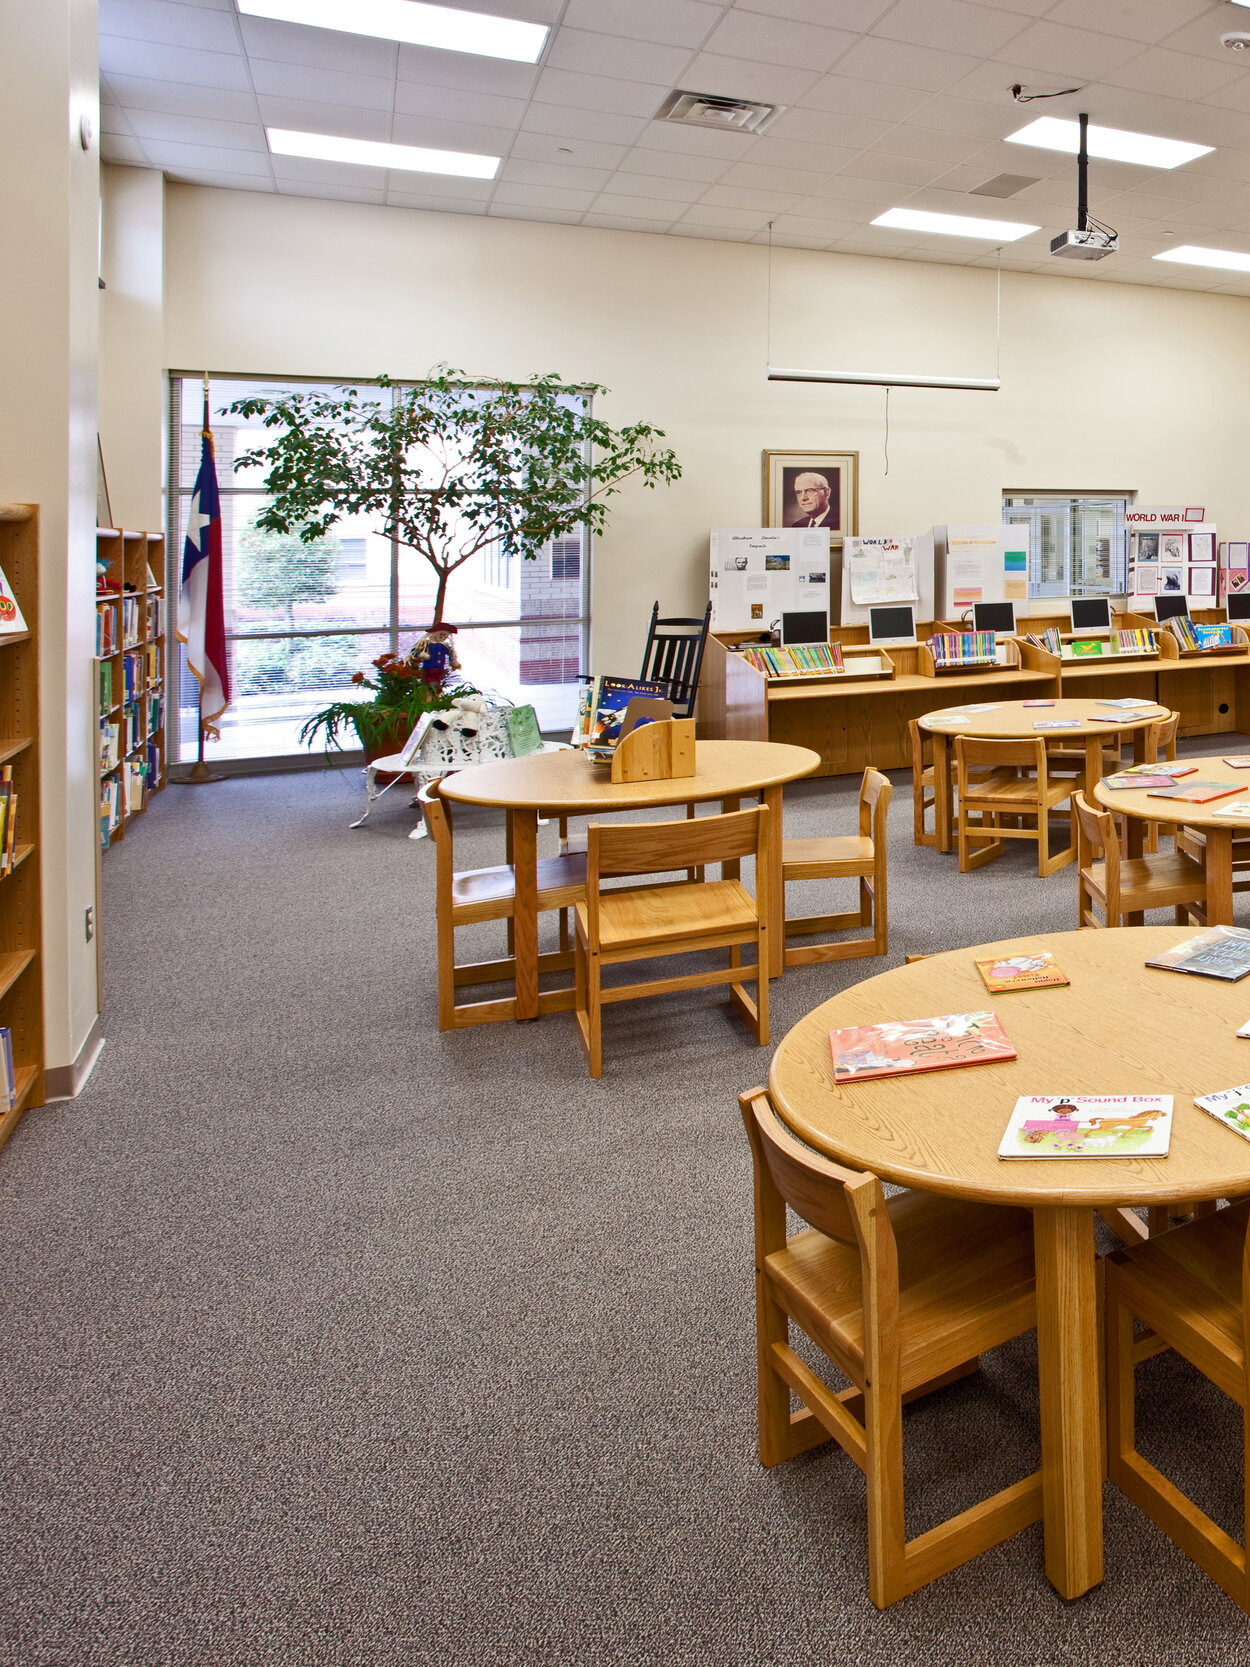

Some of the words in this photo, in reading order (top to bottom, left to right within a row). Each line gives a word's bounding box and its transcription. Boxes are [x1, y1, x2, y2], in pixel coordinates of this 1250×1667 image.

[1126, 514, 1157, 522] WORLD
[1160, 514, 1180, 522] WAR
[1030, 1096, 1054, 1104] My
[1076, 1096, 1127, 1104] Sound
[1205, 1092, 1229, 1103] My
